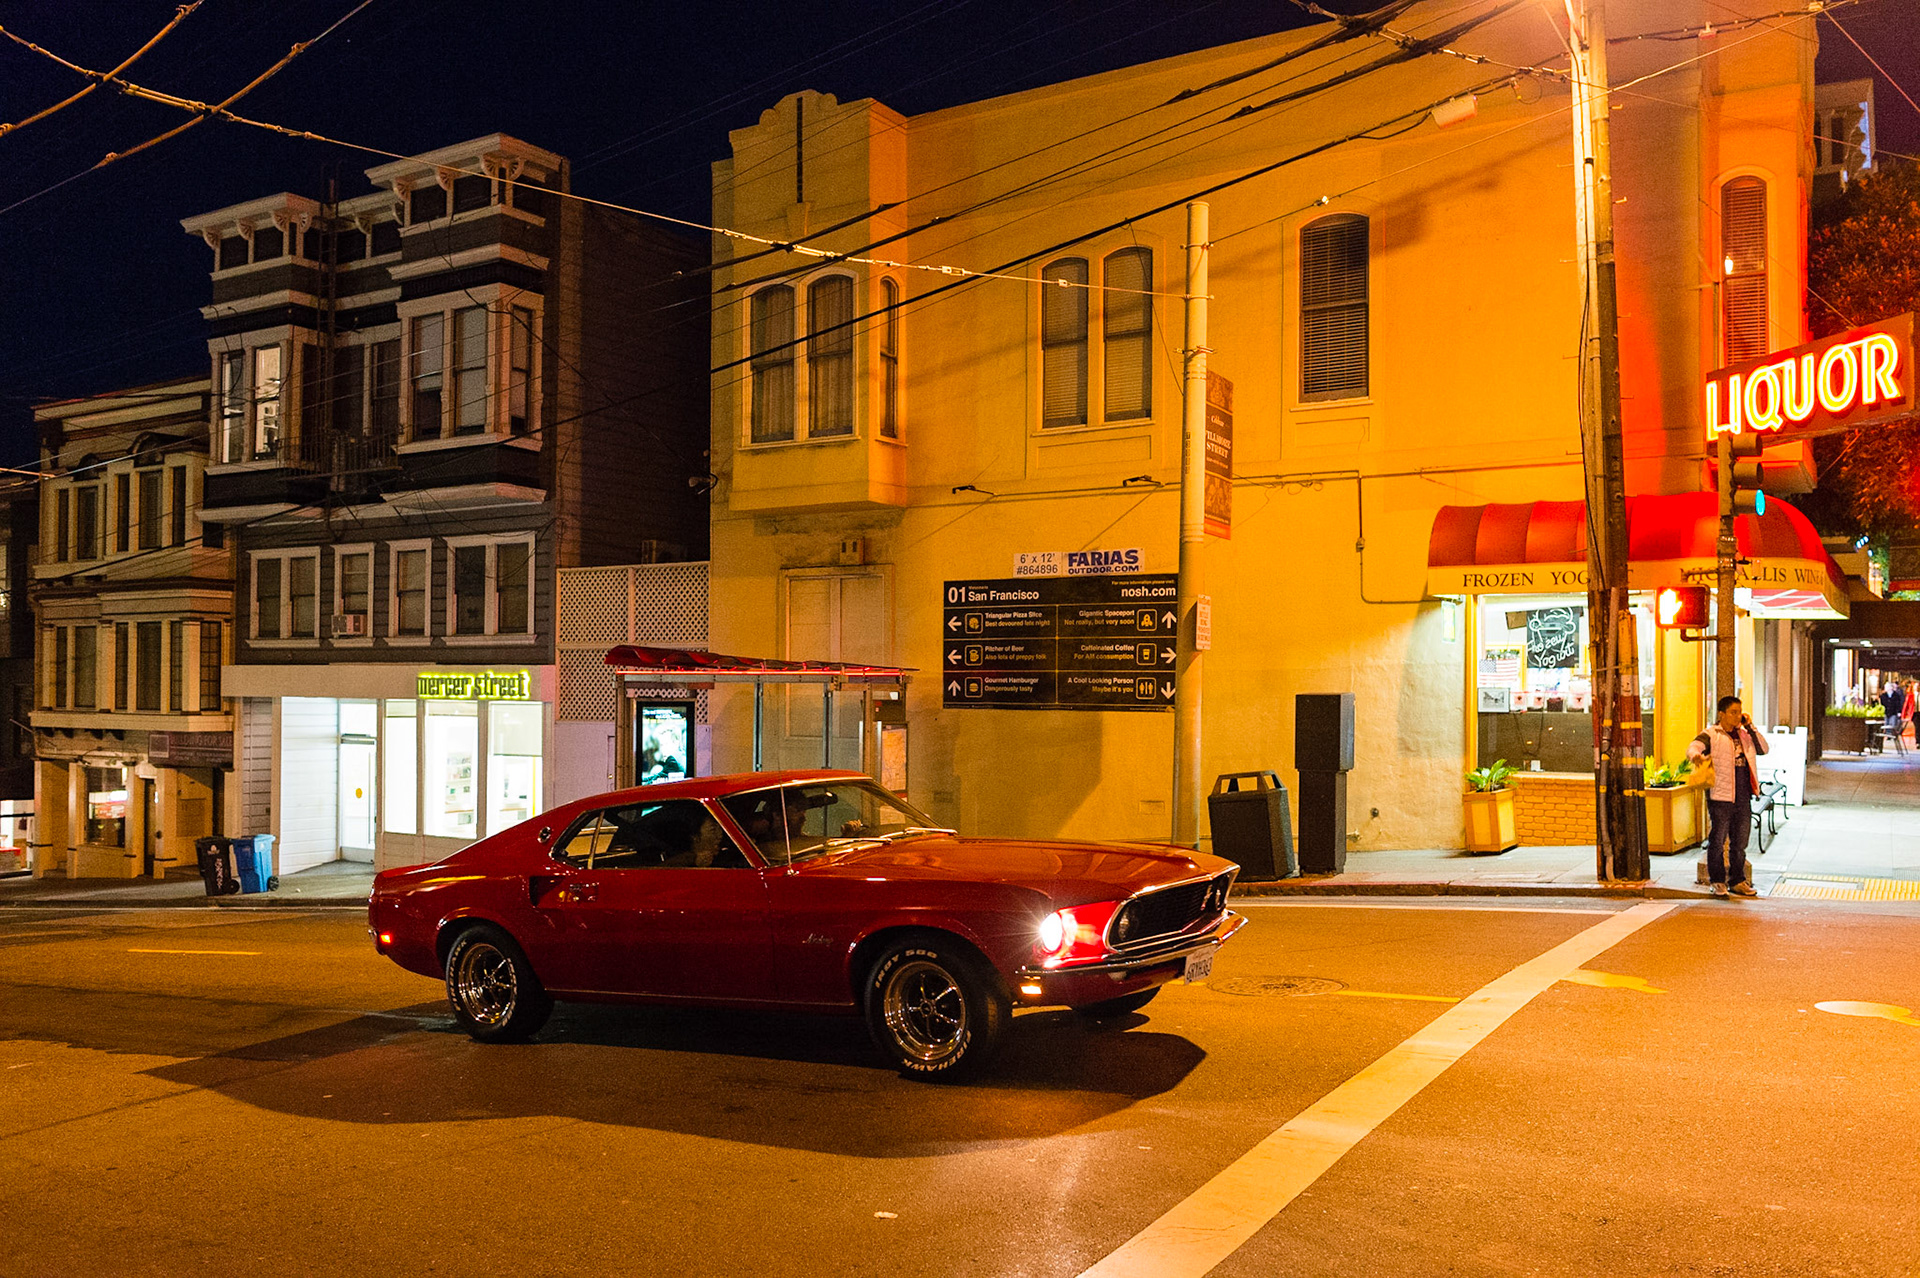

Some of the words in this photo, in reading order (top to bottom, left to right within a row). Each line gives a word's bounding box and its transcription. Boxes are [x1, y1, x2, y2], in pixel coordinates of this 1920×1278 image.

[1706, 333, 1902, 441] LIQUOR
[1020, 554, 1029, 564] 6'
[1041, 553, 1056, 563] 12'
[1068, 549, 1139, 567] FARIAS
[1016, 564, 1058, 575] #864896
[1068, 565, 1139, 575] OUTDOOR.COM
[1463, 572, 1534, 588] FROZEN
[948, 586, 966, 604] 01
[968, 591, 987, 602] San
[989, 590, 1040, 601] Francisco
[1121, 586, 1176, 597] nosh.com
[985, 612, 1012, 620] Triangular
[1079, 610, 1103, 618] Gigantic
[1104, 609, 1135, 617] Spaceport
[416, 675, 472, 697] mercer
[474, 672, 528, 697] street
[1088, 677, 1112, 685] Looking
[985, 685, 1018, 693] Dangerously
